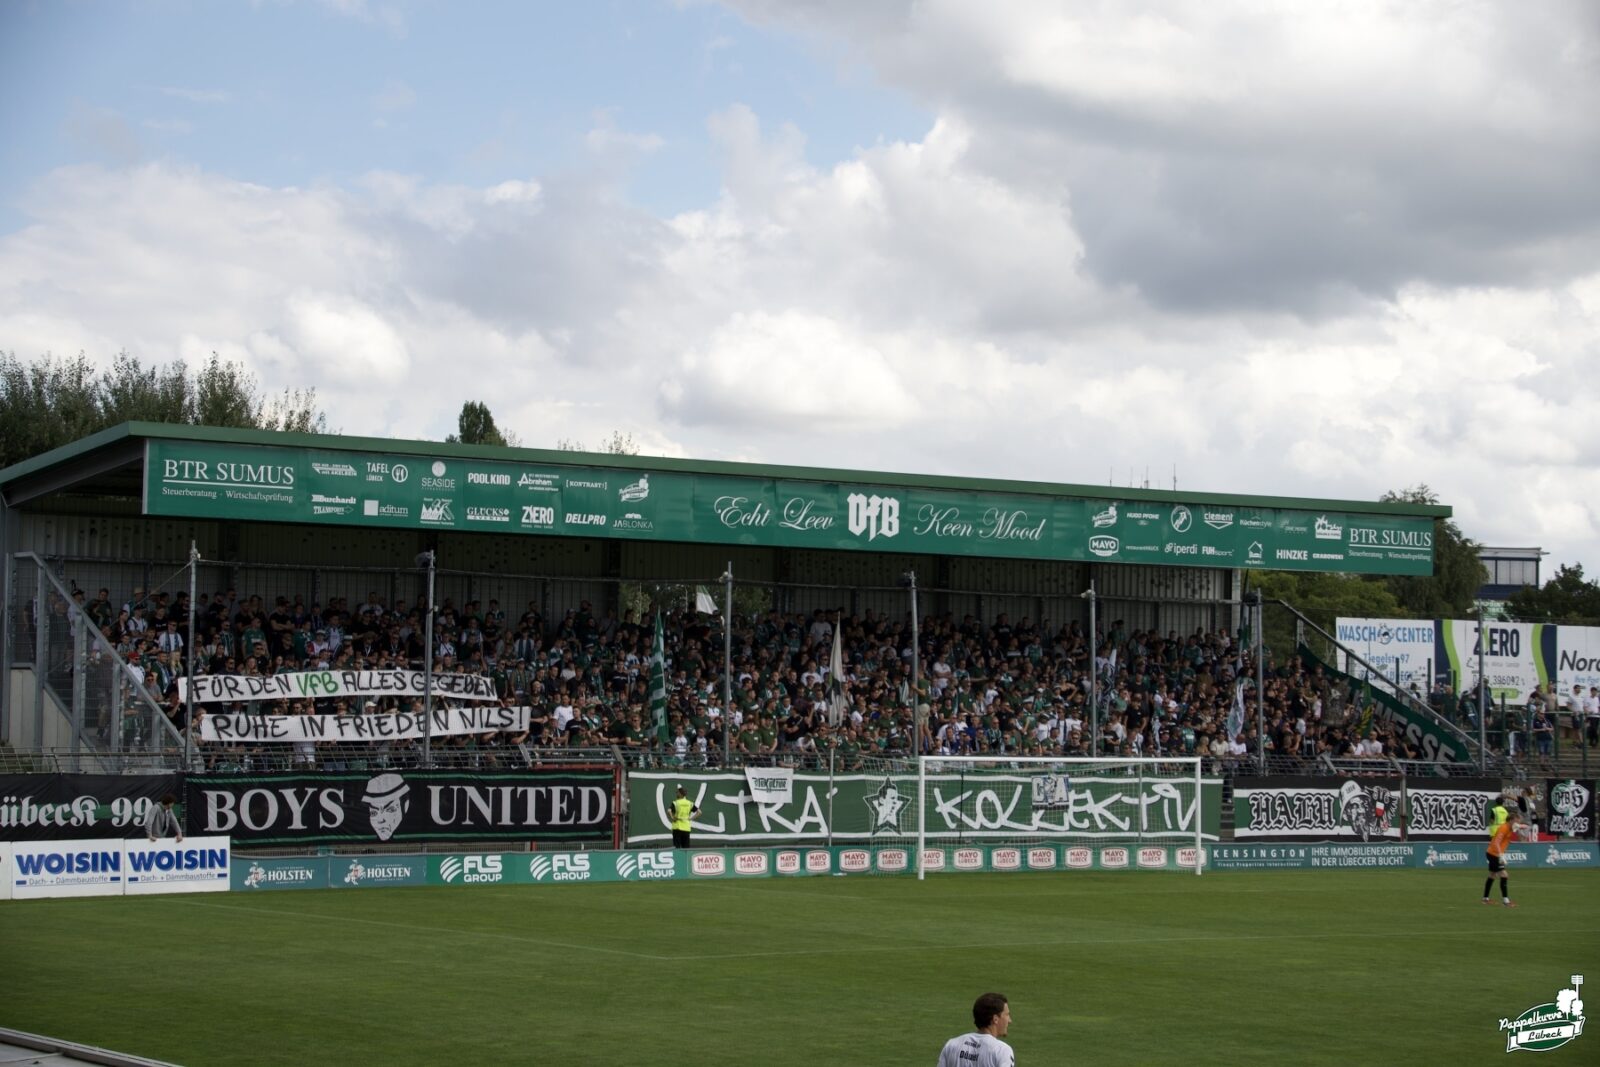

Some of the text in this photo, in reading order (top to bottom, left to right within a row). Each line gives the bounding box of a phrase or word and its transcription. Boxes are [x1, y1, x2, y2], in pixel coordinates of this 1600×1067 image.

[164, 459, 294, 484] BTR SUMUS
[366, 462, 390, 474] TAFEL
[421, 477, 455, 488] SEASIDE
[467, 472, 511, 485] POOLKIND
[162, 486, 293, 503] Steuerberatung Wirtschaftsprüfung
[565, 513, 606, 525] DELLPRO
[714, 495, 771, 528] Echt
[914, 503, 973, 537] Keen
[978, 507, 1047, 541] Mood
[1203, 512, 1234, 521] clement
[1350, 528, 1432, 546] BTR SUMUS
[1091, 540, 1116, 550] MAYO
[1173, 543, 1197, 556] iperdi
[1276, 549, 1308, 560] HINZKE
[1338, 624, 1434, 643] WASCH CENTER
[1472, 627, 1520, 657] ZERO
[193, 672, 497, 699] FÜR DEN VfB ALLES GEGEBEN
[212, 706, 523, 740] RUHE IN FRIEDEN NILS!
[111, 796, 153, 828] 99
[202, 785, 607, 832] BOYS UNITED
[809, 853, 827, 861] MAYO
[843, 853, 866, 861] MAYO
[1213, 849, 1306, 858] KENSINGTON
[1312, 847, 1413, 856] IHRE IMMOBILIENEXPERTEN
[1439, 852, 1469, 861] HOLSTEN
[1560, 851, 1591, 860] HOLSTEN
[16, 851, 120, 875] WOISIN
[128, 848, 227, 872] WOISIN
[463, 855, 502, 874] FLS
[553, 853, 590, 871] FLS
[637, 852, 675, 870] FLS
[1312, 855, 1405, 866] IN DER LÜBECKER BUCHT.
[140, 874, 158, 882] Dach-
[165, 871, 216, 881] Dämmbaustoffe
[268, 869, 313, 881] HOLSTEN
[367, 867, 411, 878] HOLSTEN
[463, 873, 503, 883] GROUP
[553, 871, 590, 880] GROUP
[638, 869, 675, 879] GROUP
[29, 878, 48, 886] Dach-
[56, 875, 109, 885] Dämmbaustoffe
